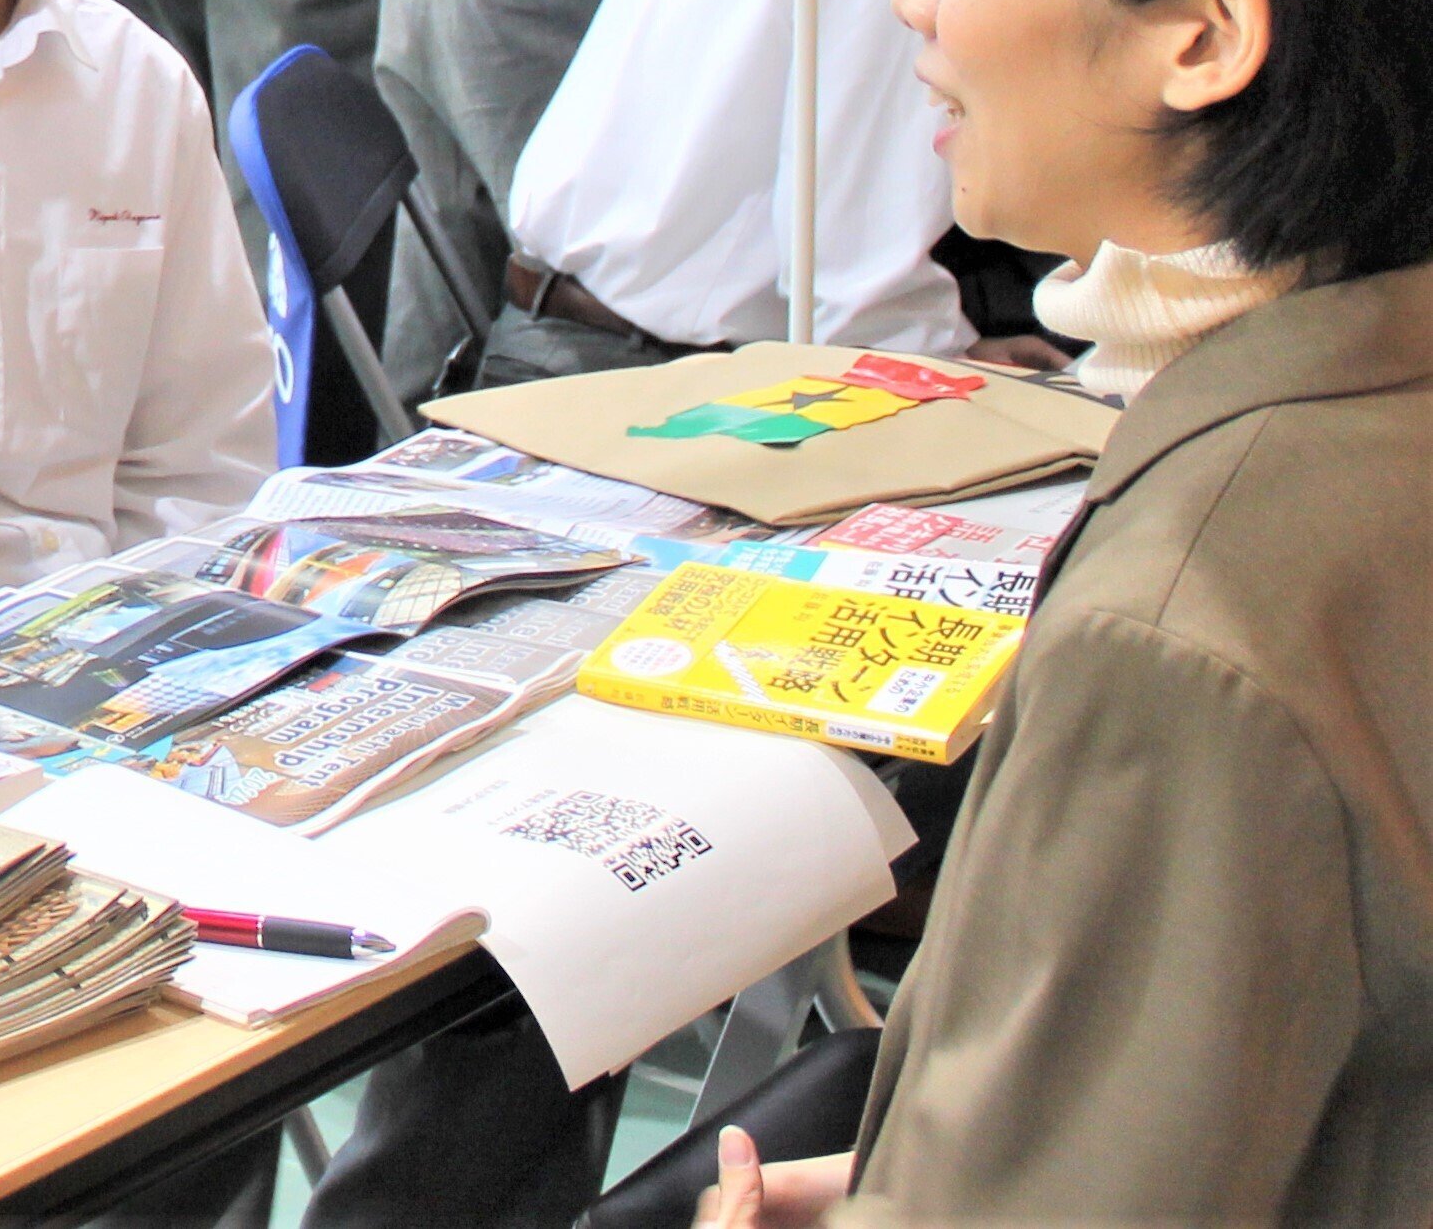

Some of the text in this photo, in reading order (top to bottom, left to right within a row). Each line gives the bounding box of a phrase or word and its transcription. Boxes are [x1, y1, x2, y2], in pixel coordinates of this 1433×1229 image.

[765, 596, 887, 697] 活用戦略
[820, 606, 934, 707] インターン
[907, 614, 987, 668] 長期
[265, 676, 407, 743] Program
[886, 669, 918, 695] ための
[892, 672, 937, 714] 中小企業の
[277, 683, 443, 769] Internship
[296, 693, 474, 788] Maruhachi Tent
